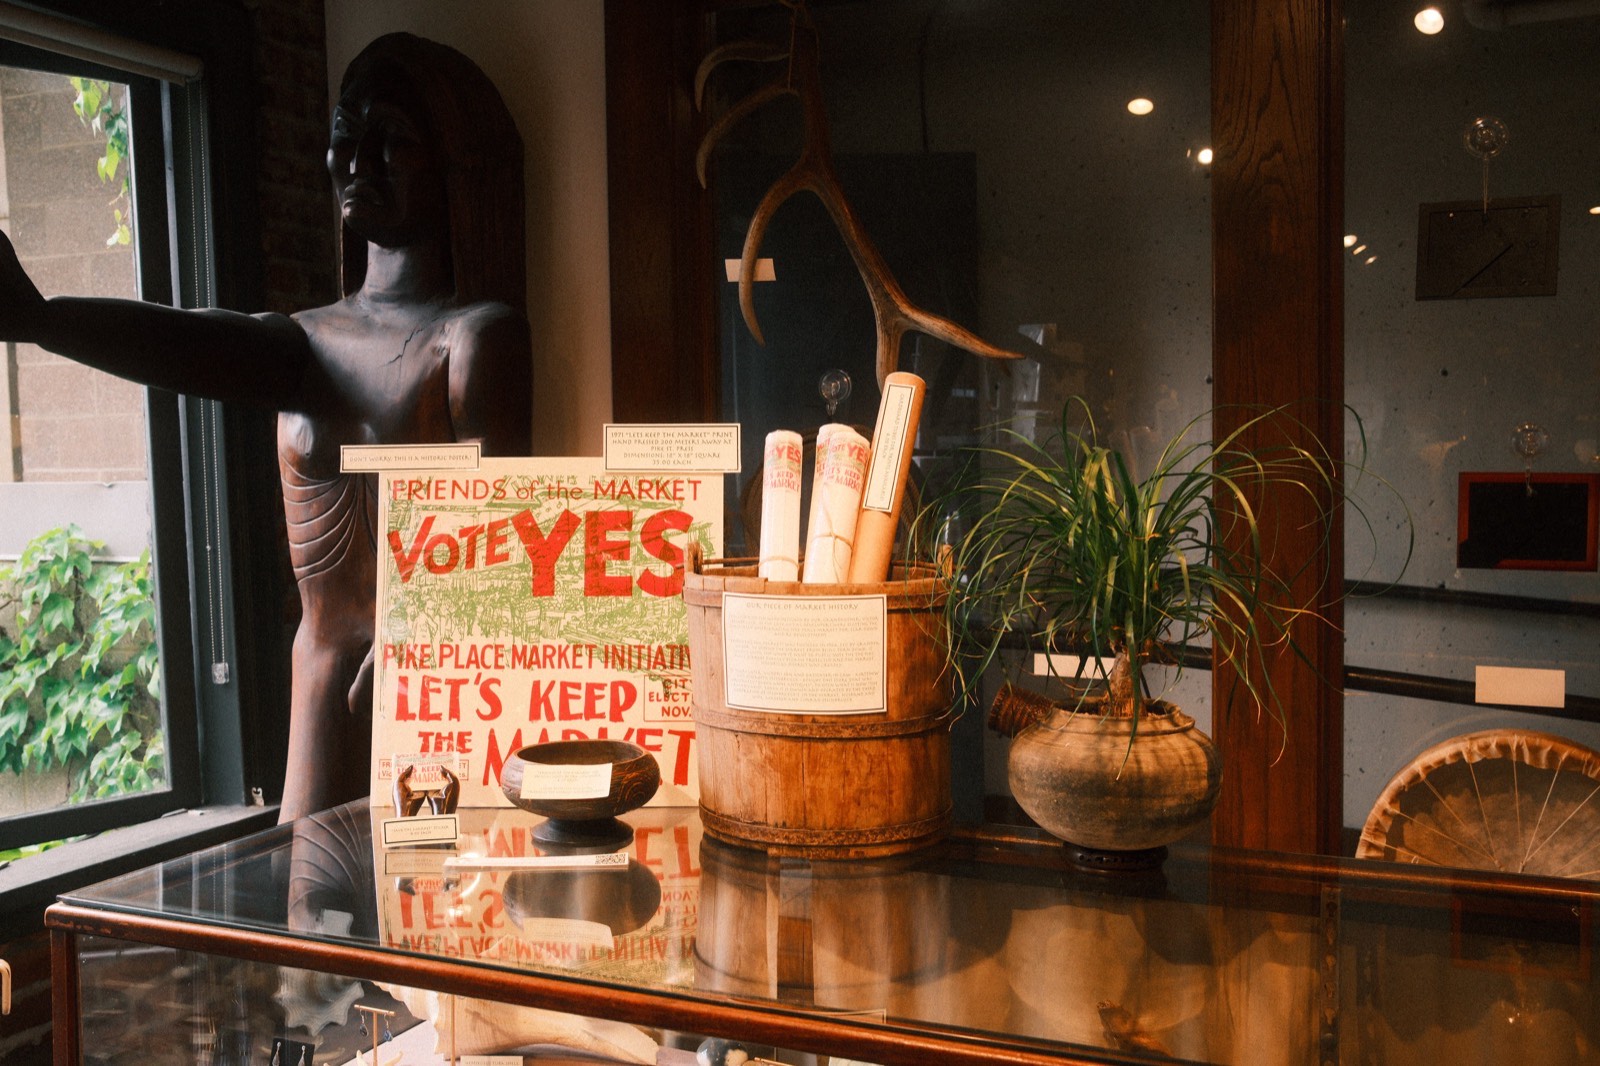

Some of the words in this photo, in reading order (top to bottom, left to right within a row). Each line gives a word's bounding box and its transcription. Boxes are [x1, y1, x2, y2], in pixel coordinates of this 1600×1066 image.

[393, 480, 506, 500] FRIENDS
[516, 480, 539, 500] of
[547, 480, 583, 500] the
[594, 479, 702, 500] MARKET
[511, 508, 694, 598] YES
[383, 644, 432, 670] PIKE
[438, 644, 504, 670] PLACE
[511, 644, 593, 670] MARKET
[662, 678, 692, 690] CIT
[395, 672, 502, 722] LET'S
[528, 680, 638, 722] KEEP
[662, 706, 692, 718] NOV.
[418, 730, 472, 754] THE
